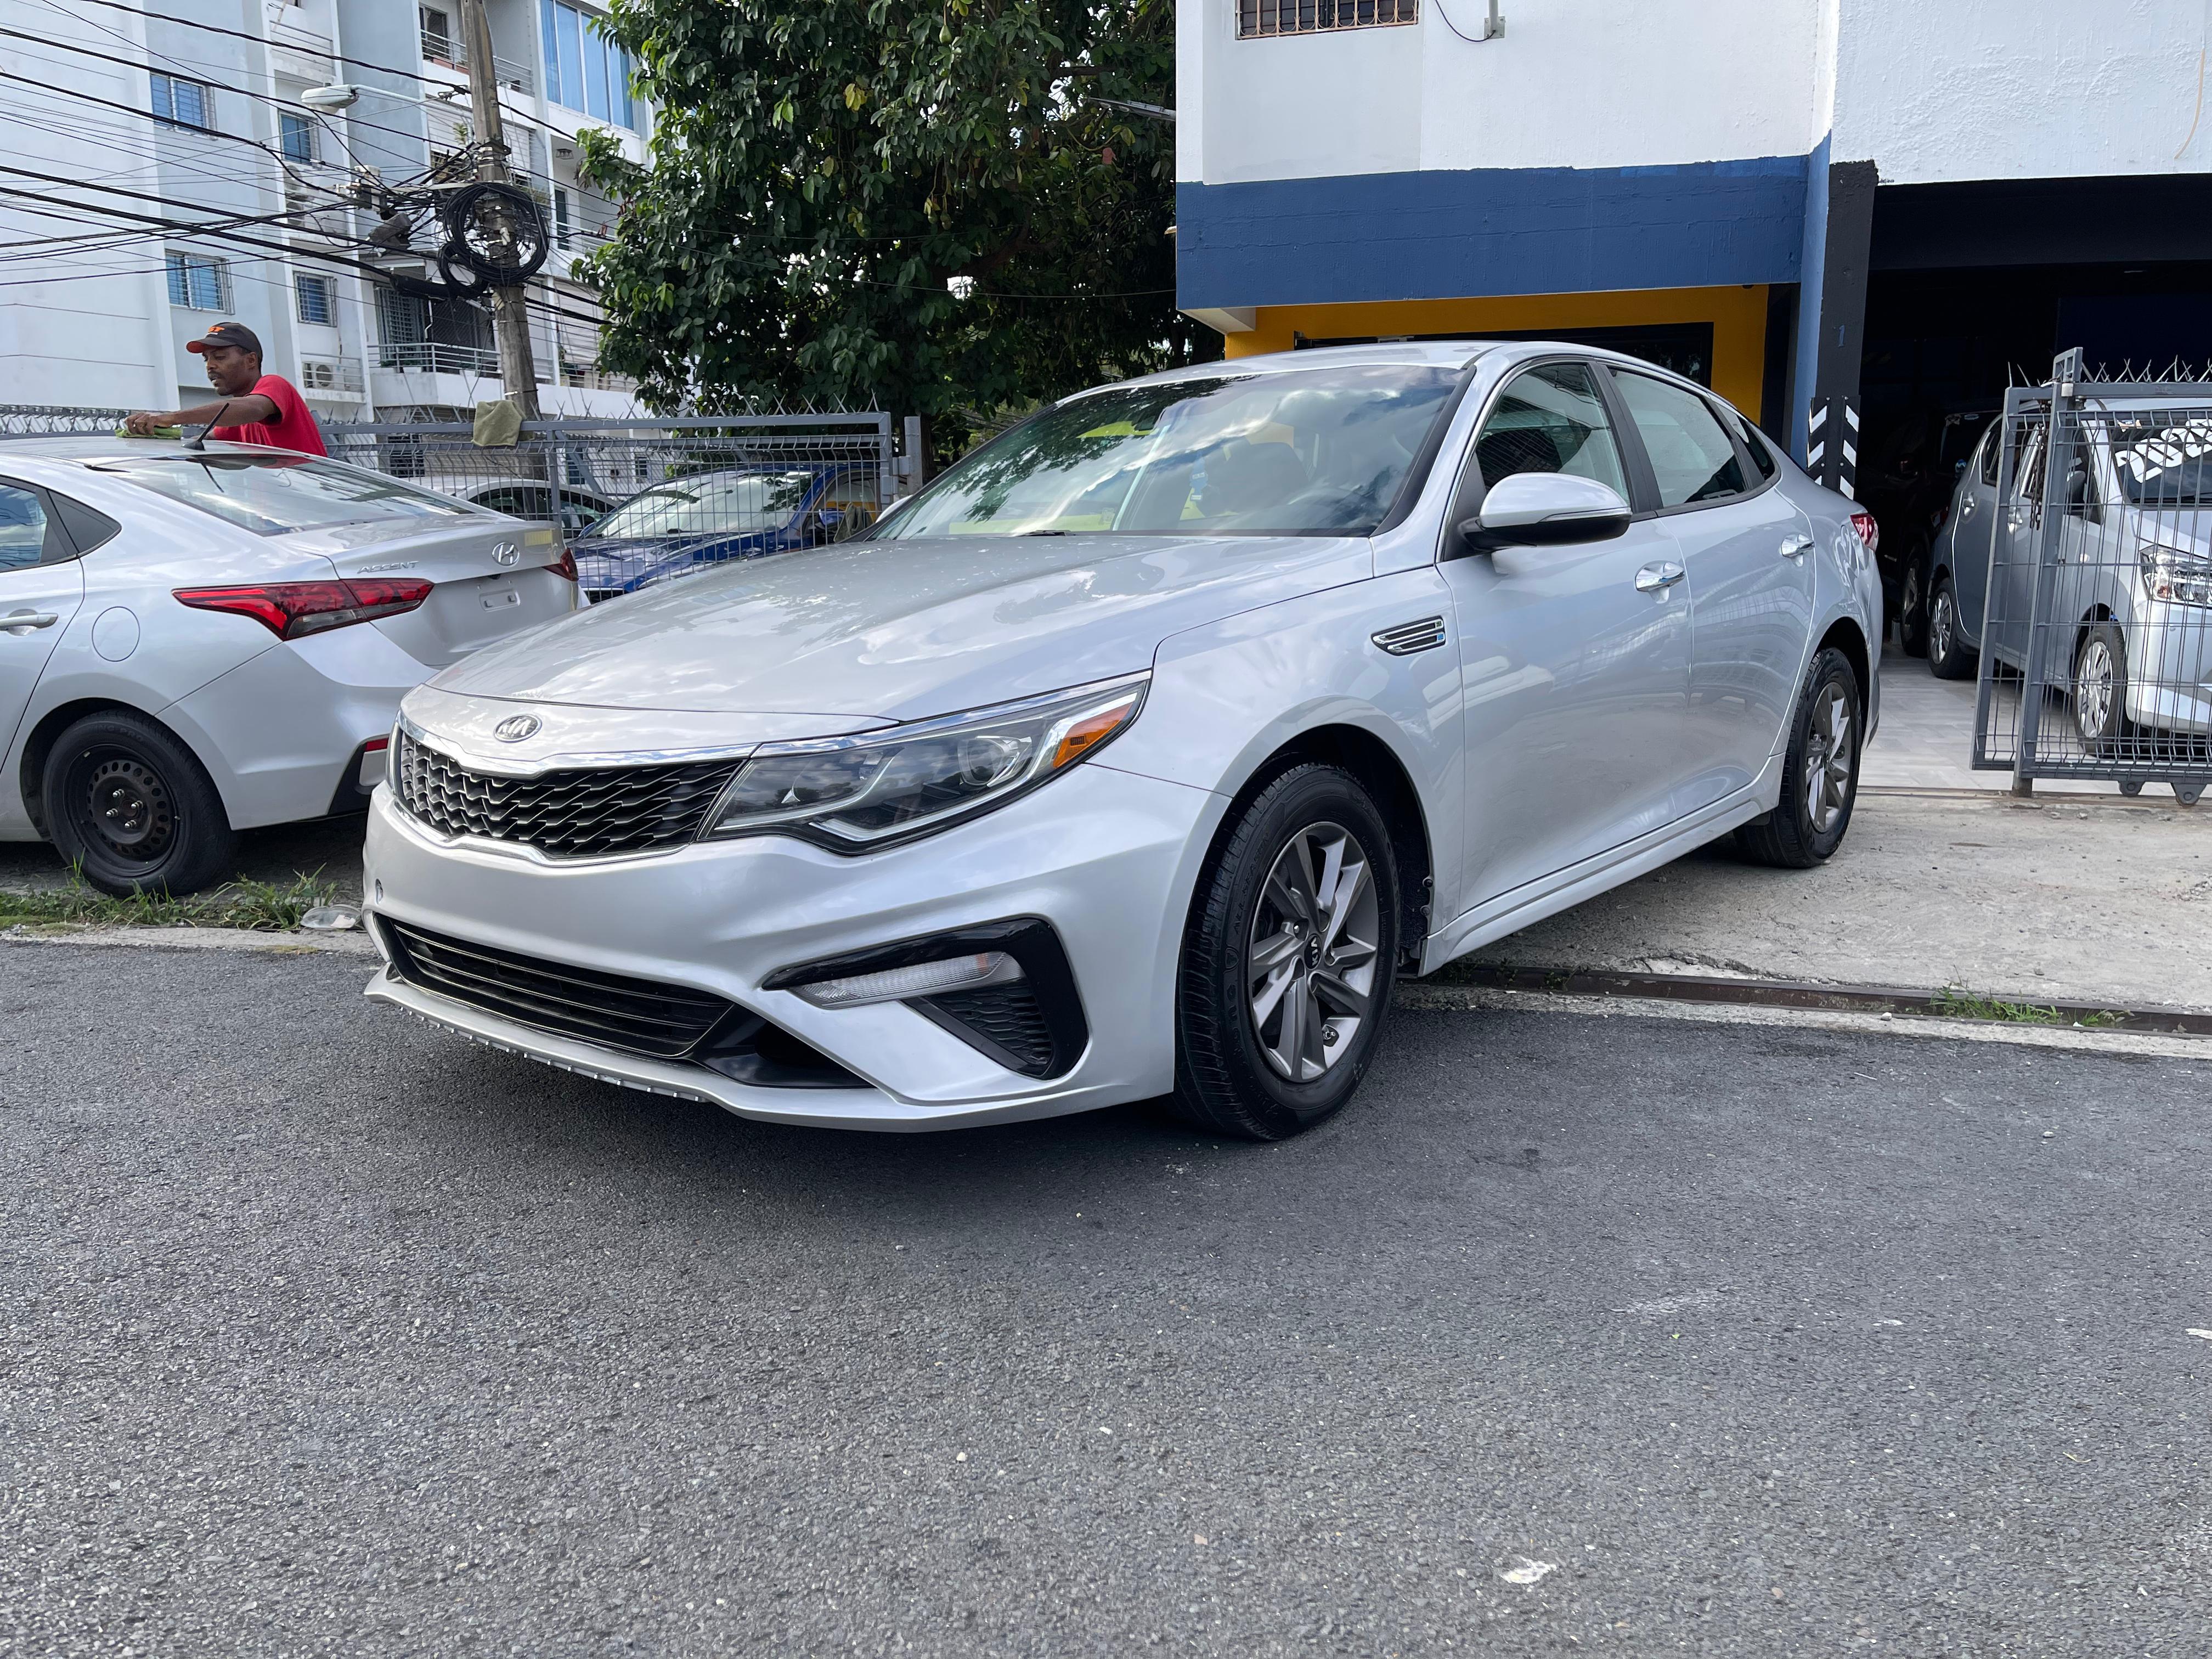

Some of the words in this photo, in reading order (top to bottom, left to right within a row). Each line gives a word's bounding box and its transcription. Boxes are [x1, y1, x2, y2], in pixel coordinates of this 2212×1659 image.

[357, 560, 419, 574] ACCENT
[496, 718, 532, 736] KIA
[1311, 937, 1319, 966] KIA
